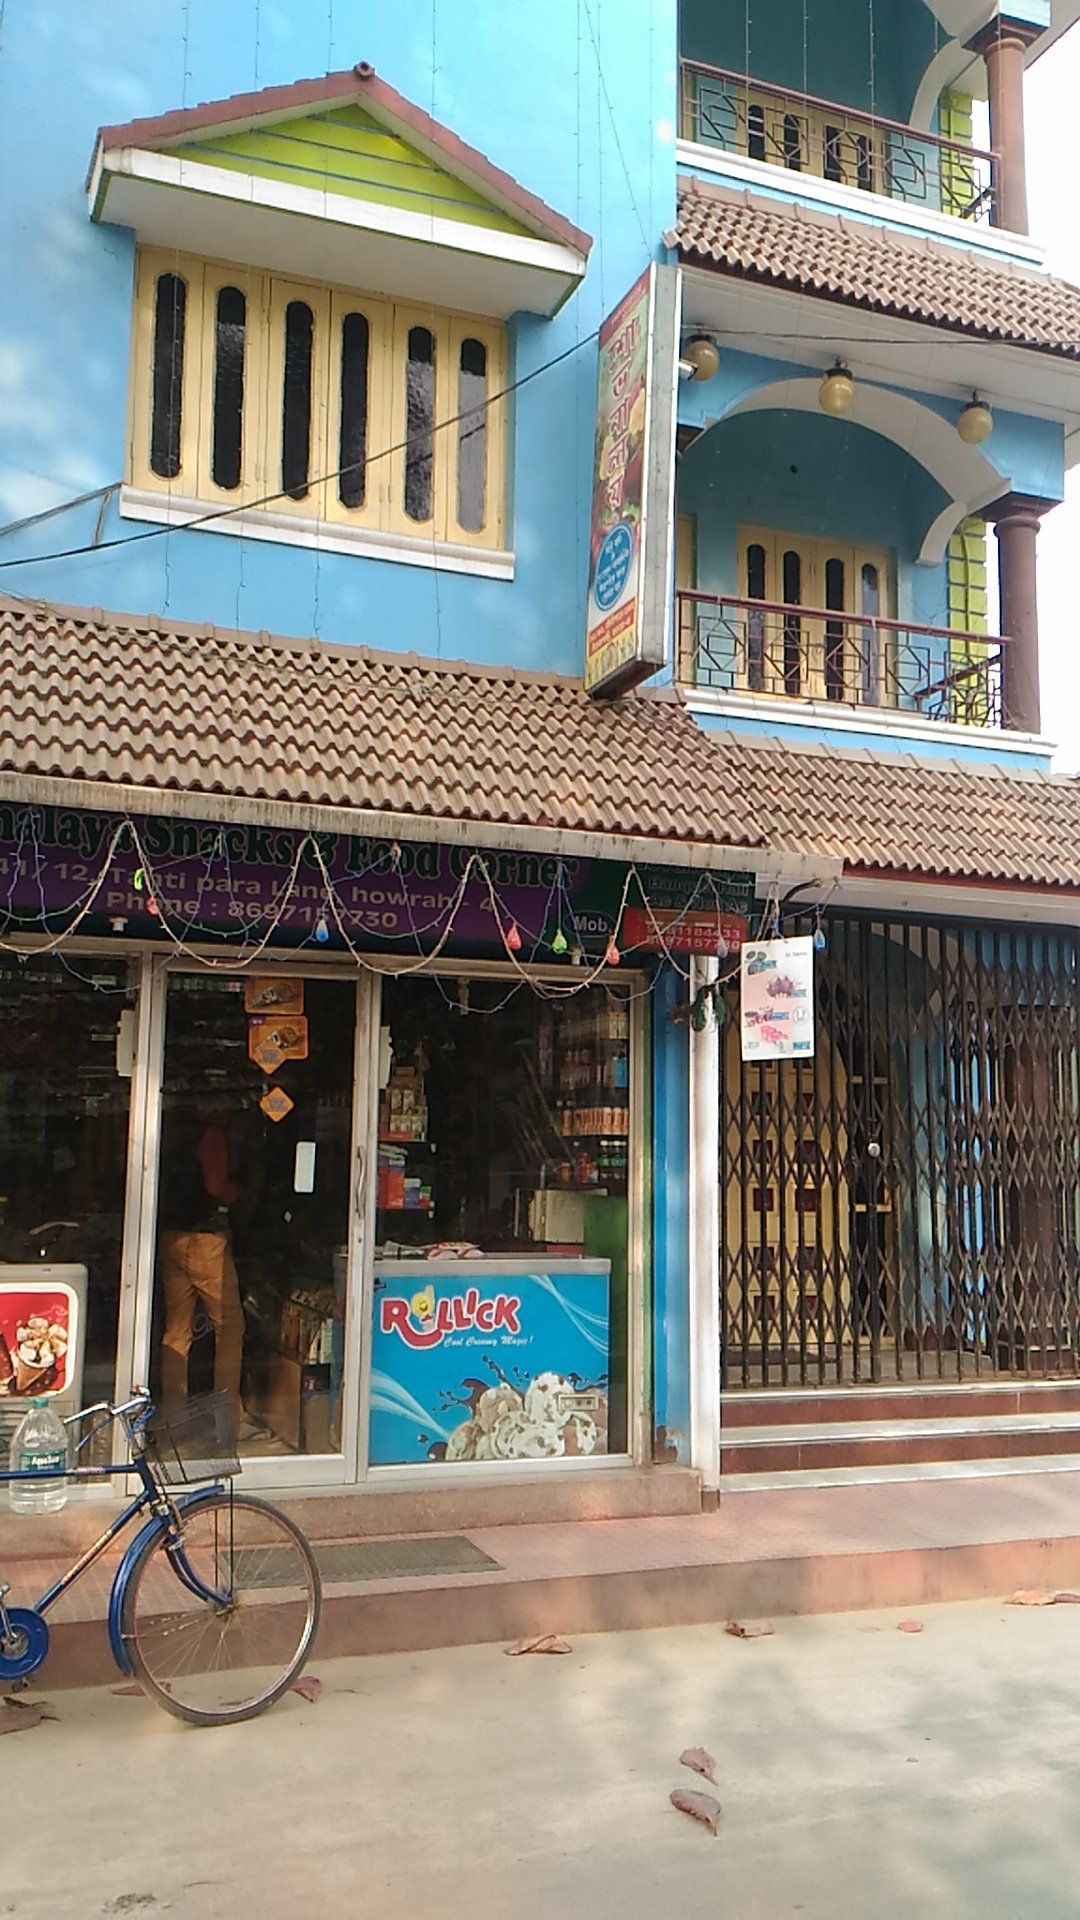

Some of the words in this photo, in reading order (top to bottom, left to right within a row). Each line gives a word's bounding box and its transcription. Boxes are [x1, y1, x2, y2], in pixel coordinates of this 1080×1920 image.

[144, 816, 296, 869] Snacks
[302, 831, 339, 871] &
[345, 834, 441, 880] Food
[449, 846, 581, 890] Corner
[196, 876, 262, 895] para
[107, 891, 198, 915] Phne
